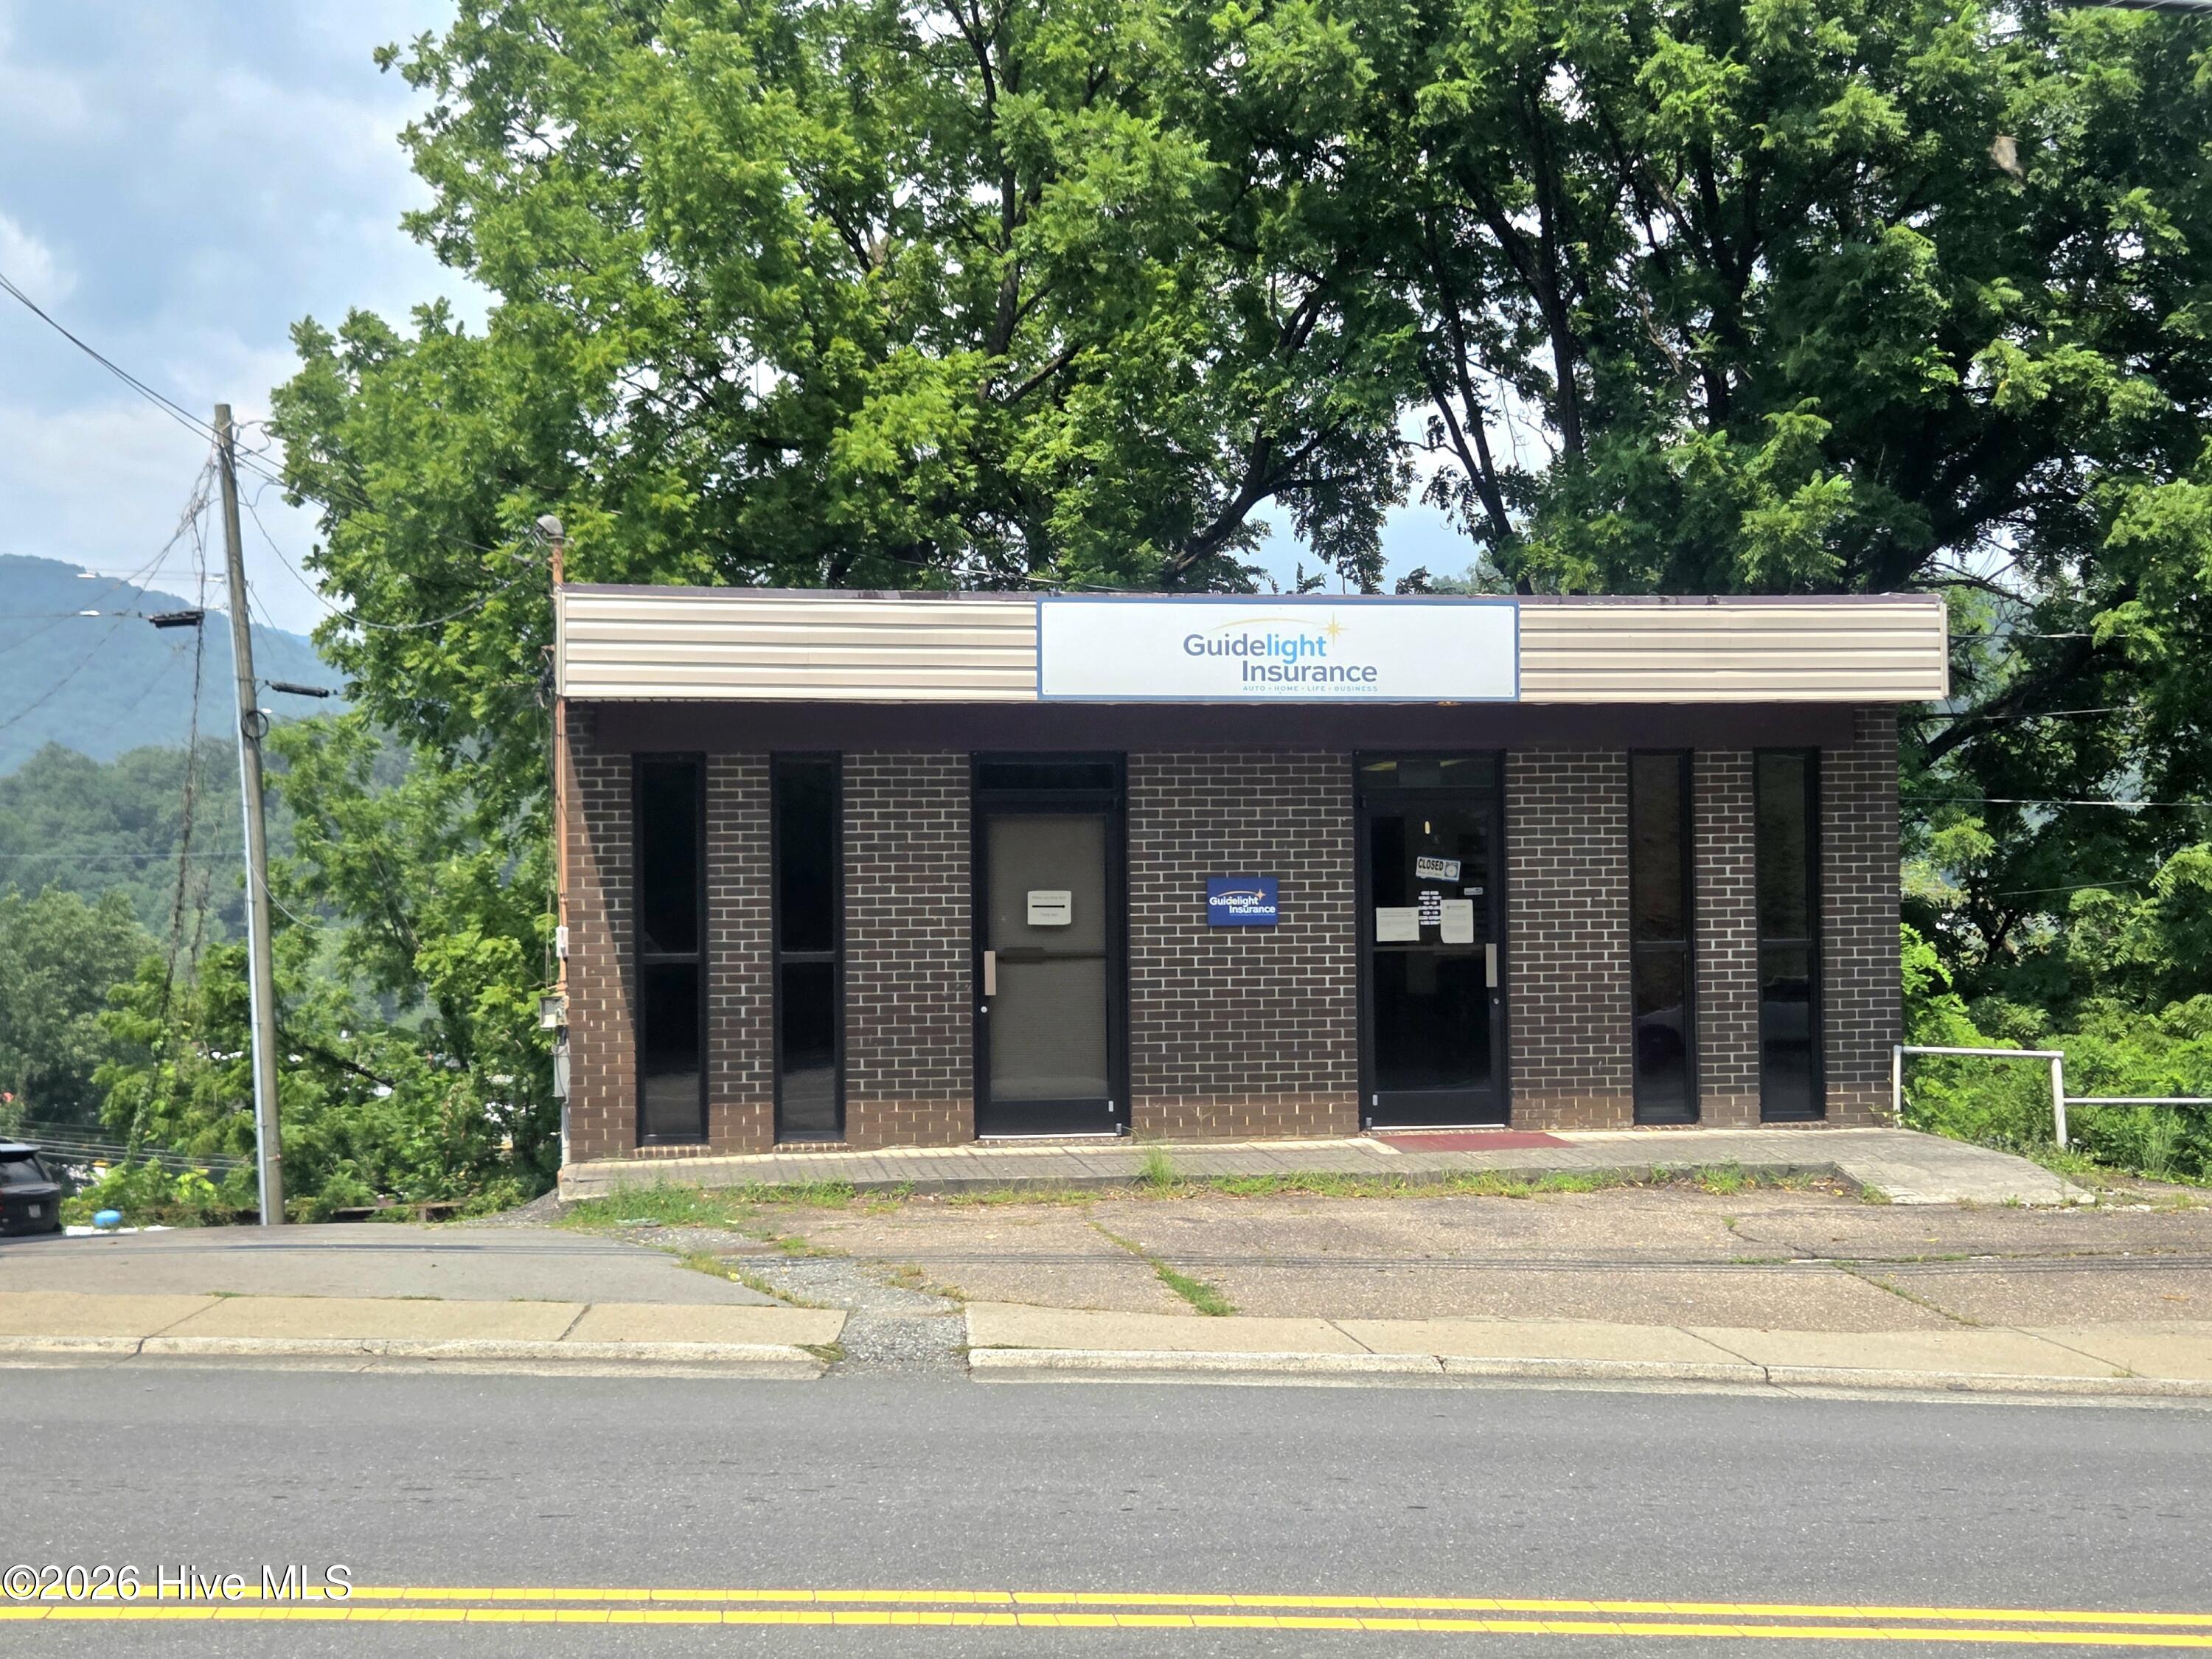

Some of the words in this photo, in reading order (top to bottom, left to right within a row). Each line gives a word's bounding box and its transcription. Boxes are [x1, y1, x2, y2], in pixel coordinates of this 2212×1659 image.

[1183, 633, 1327, 664] Guidelight
[1242, 660, 1378, 683] Insurance
[1418, 858, 1444, 872] CLOSED
[1209, 895, 1259, 907] Guidelight
[1229, 905, 1276, 914] Insurance
